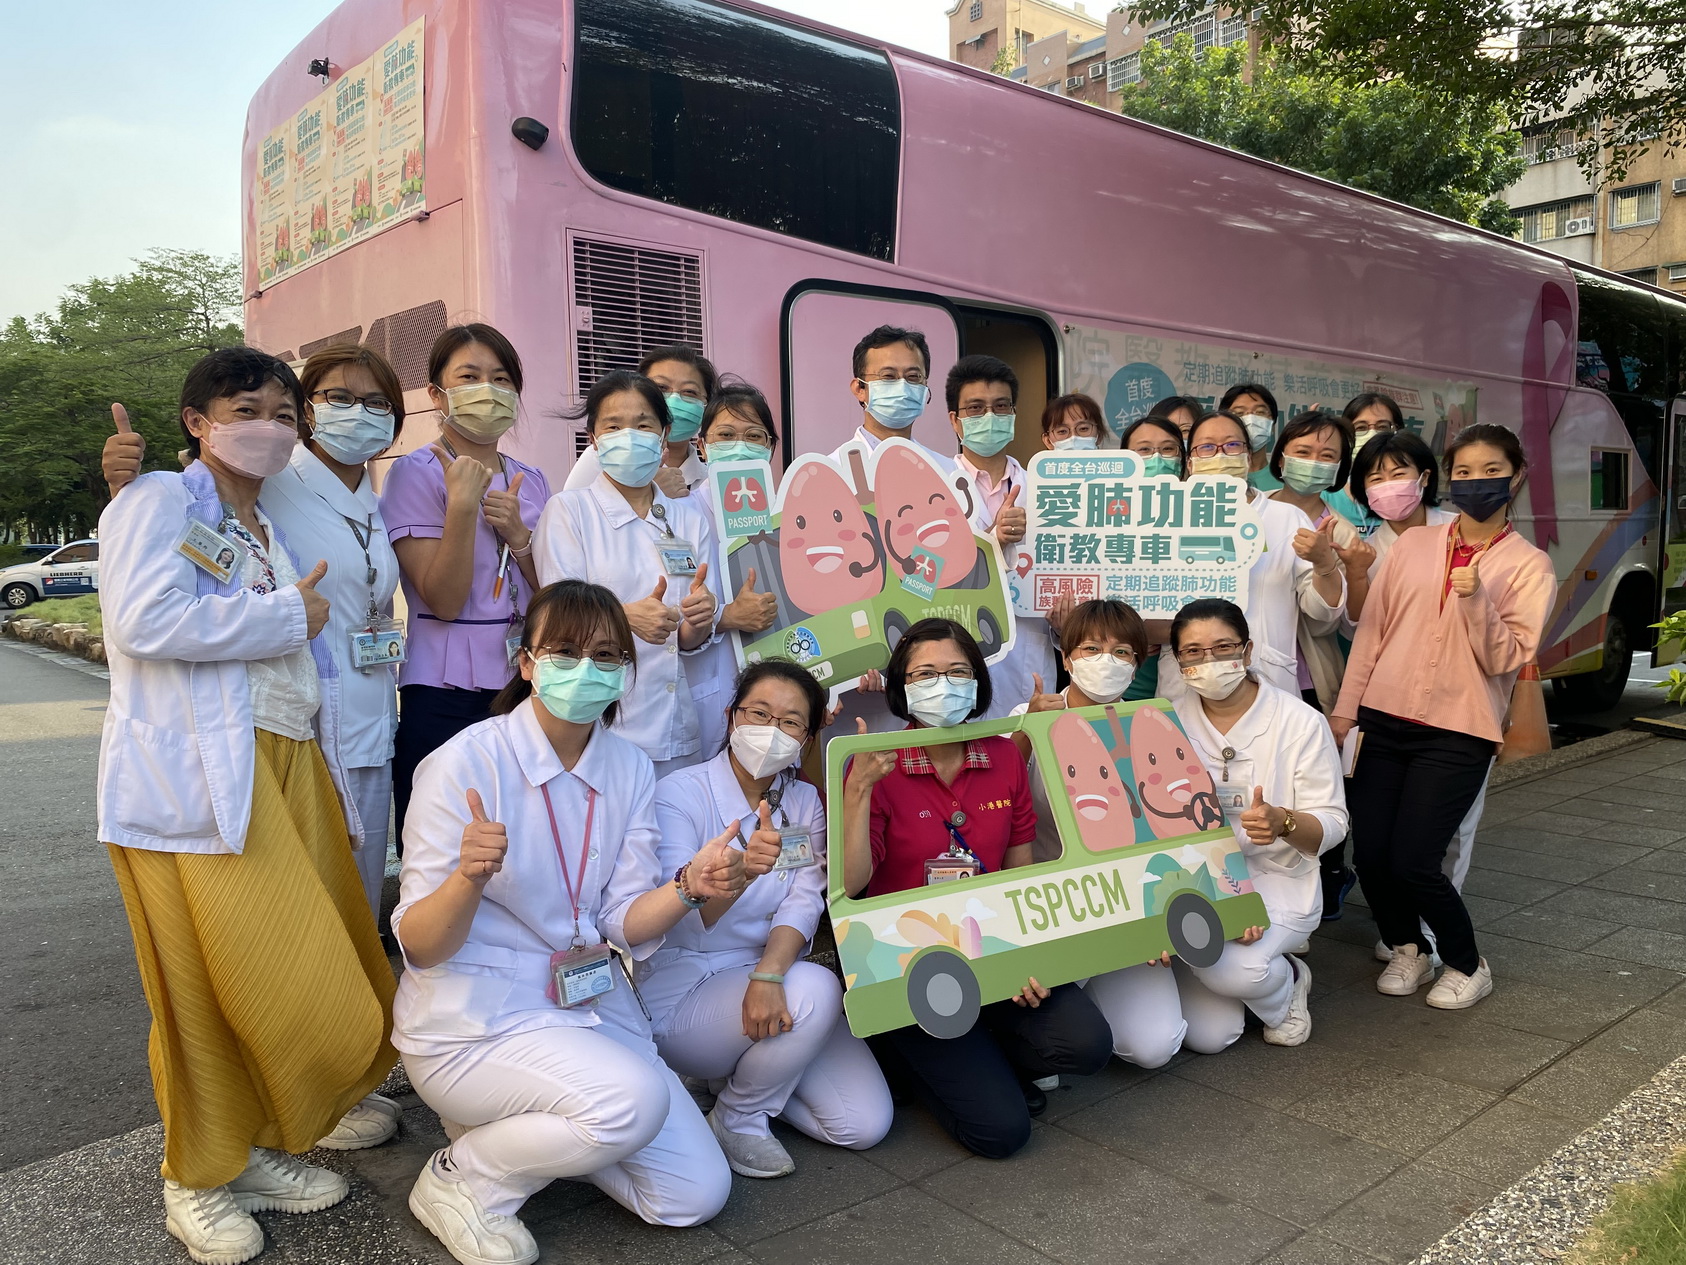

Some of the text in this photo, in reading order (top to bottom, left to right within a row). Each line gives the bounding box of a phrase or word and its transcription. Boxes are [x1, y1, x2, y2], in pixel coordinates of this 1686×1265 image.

[1125, 377, 1154, 402] 首度
[1044, 461, 1124, 475] 首度全台巡迴
[1036, 482, 1237, 528] 愛肺功能
[728, 514, 768, 530] PASSPORT
[1035, 533, 1172, 565] 衛教專車
[904, 576, 934, 596] PASSPORT
[1039, 577, 1094, 595] 高風險
[1105, 574, 1238, 593] 定期追蹤肺功能
[978, 799, 1012, 811] 小港醫院
[1004, 868, 1130, 935] TSPCCM
